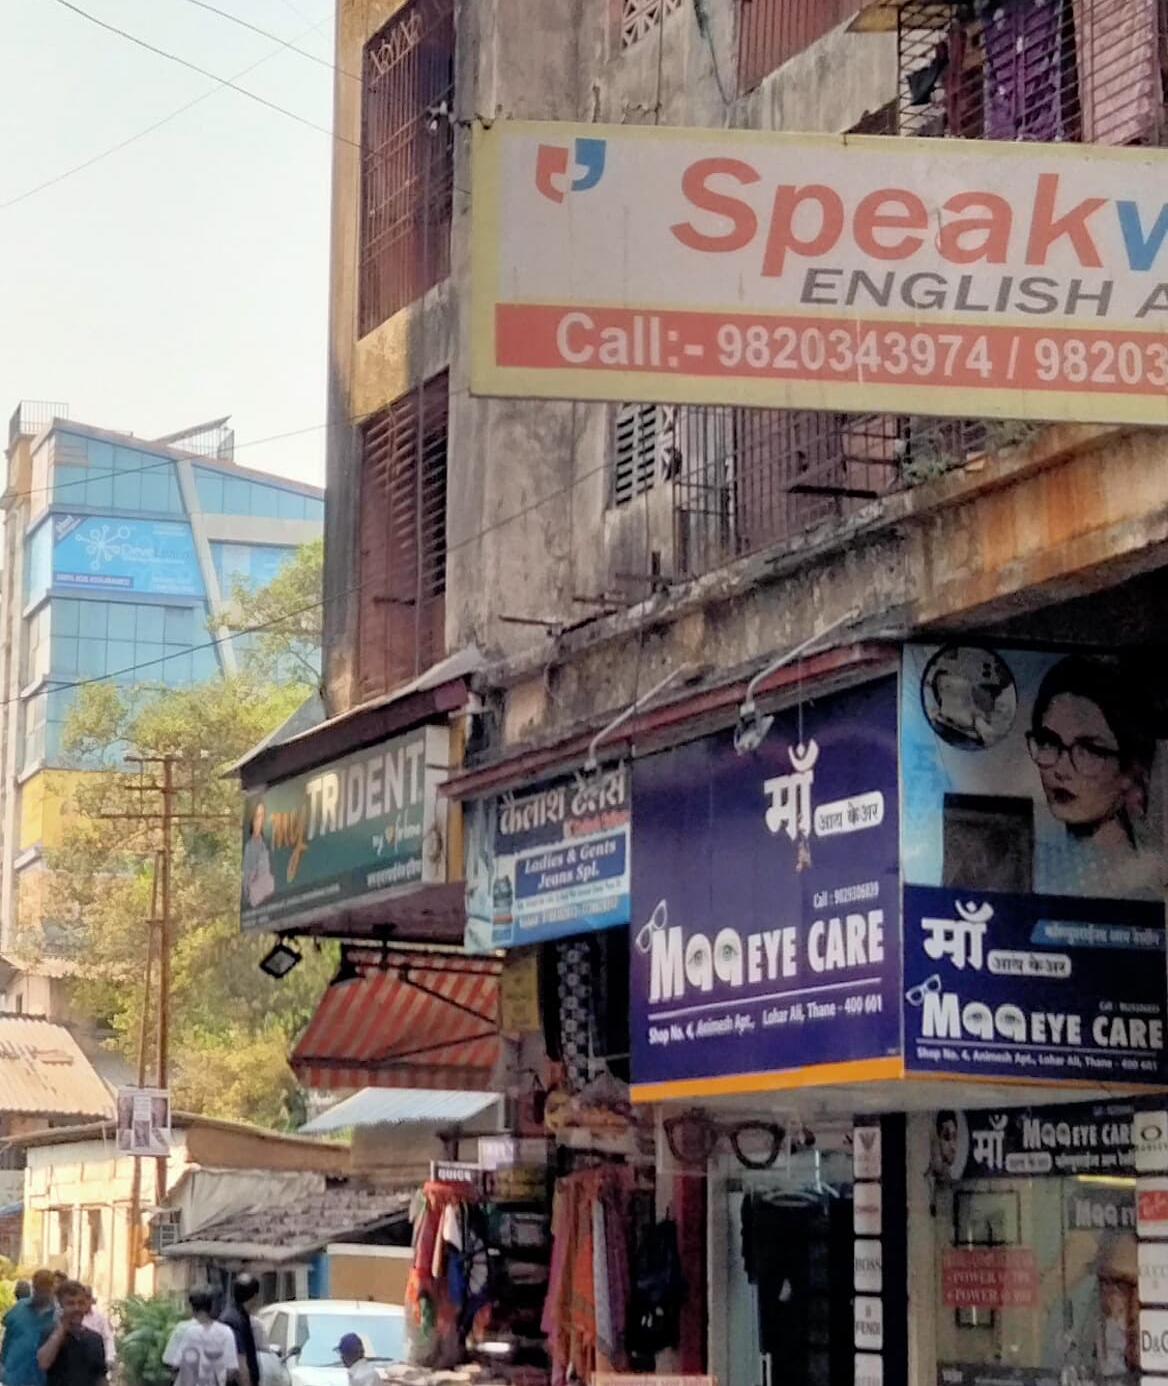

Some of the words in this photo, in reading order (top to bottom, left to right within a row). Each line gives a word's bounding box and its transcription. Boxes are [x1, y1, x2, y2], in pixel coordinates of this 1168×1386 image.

[799, 268, 1113, 318] ENGLISH
[717, 324, 993, 381] 9820343974
[306, 741, 425, 841] TRIDENT
[524, 855, 564, 875] Ladies
[566, 849, 577, 864] &
[580, 840, 617, 860] Gents
[537, 869, 573, 889] Jeans
[576, 861, 600, 882] Spl.
[808, 909, 884, 973] CARE
[649, 1025, 669, 1046] Shop
[671, 1025, 684, 1043] No.
[695, 1014, 733, 1038] Animesh
[763, 1006, 787, 1027] Lohar
[807, 1000, 835, 1020] Thane
[844, 995, 862, 1015] 400
[865, 993, 882, 1014] 601
[1092, 1015, 1164, 1049] CARE
[917, 1047, 941, 1063] Shop
[943, 1047, 959, 1061] No.
[973, 1050, 1013, 1063] Animesh
[1039, 1054, 1064, 1067] Lohar
[1085, 1057, 1112, 1070] Thane
